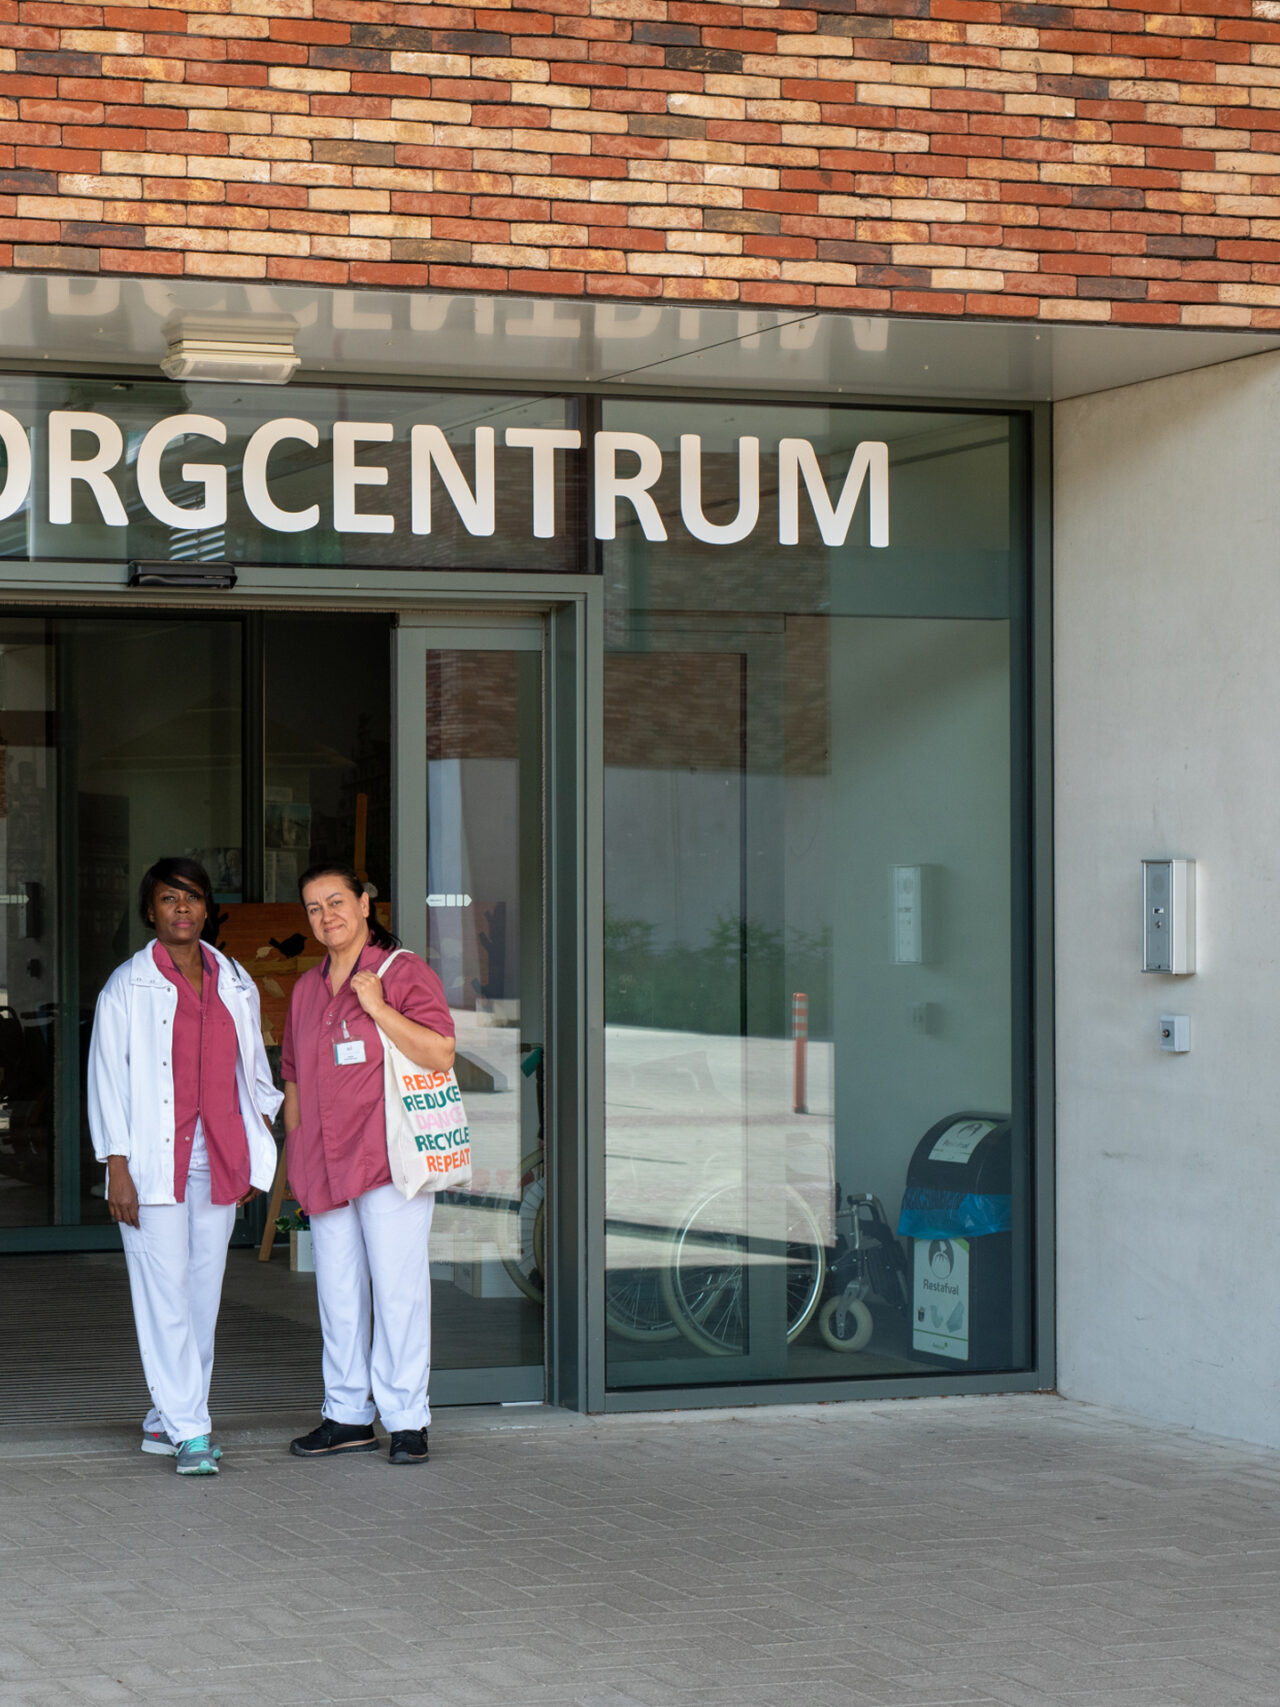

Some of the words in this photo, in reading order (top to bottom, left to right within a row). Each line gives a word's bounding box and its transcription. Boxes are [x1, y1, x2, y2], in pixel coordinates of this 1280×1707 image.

[402, 1070, 452, 1092] REUSE
[402, 1085, 461, 1112] REDUCE
[415, 1106, 465, 1131] DANCE
[414, 1126, 470, 1152] RECYCLE
[426, 1148, 470, 1173] REPEAT
[922, 1278, 960, 1297] Restafval
